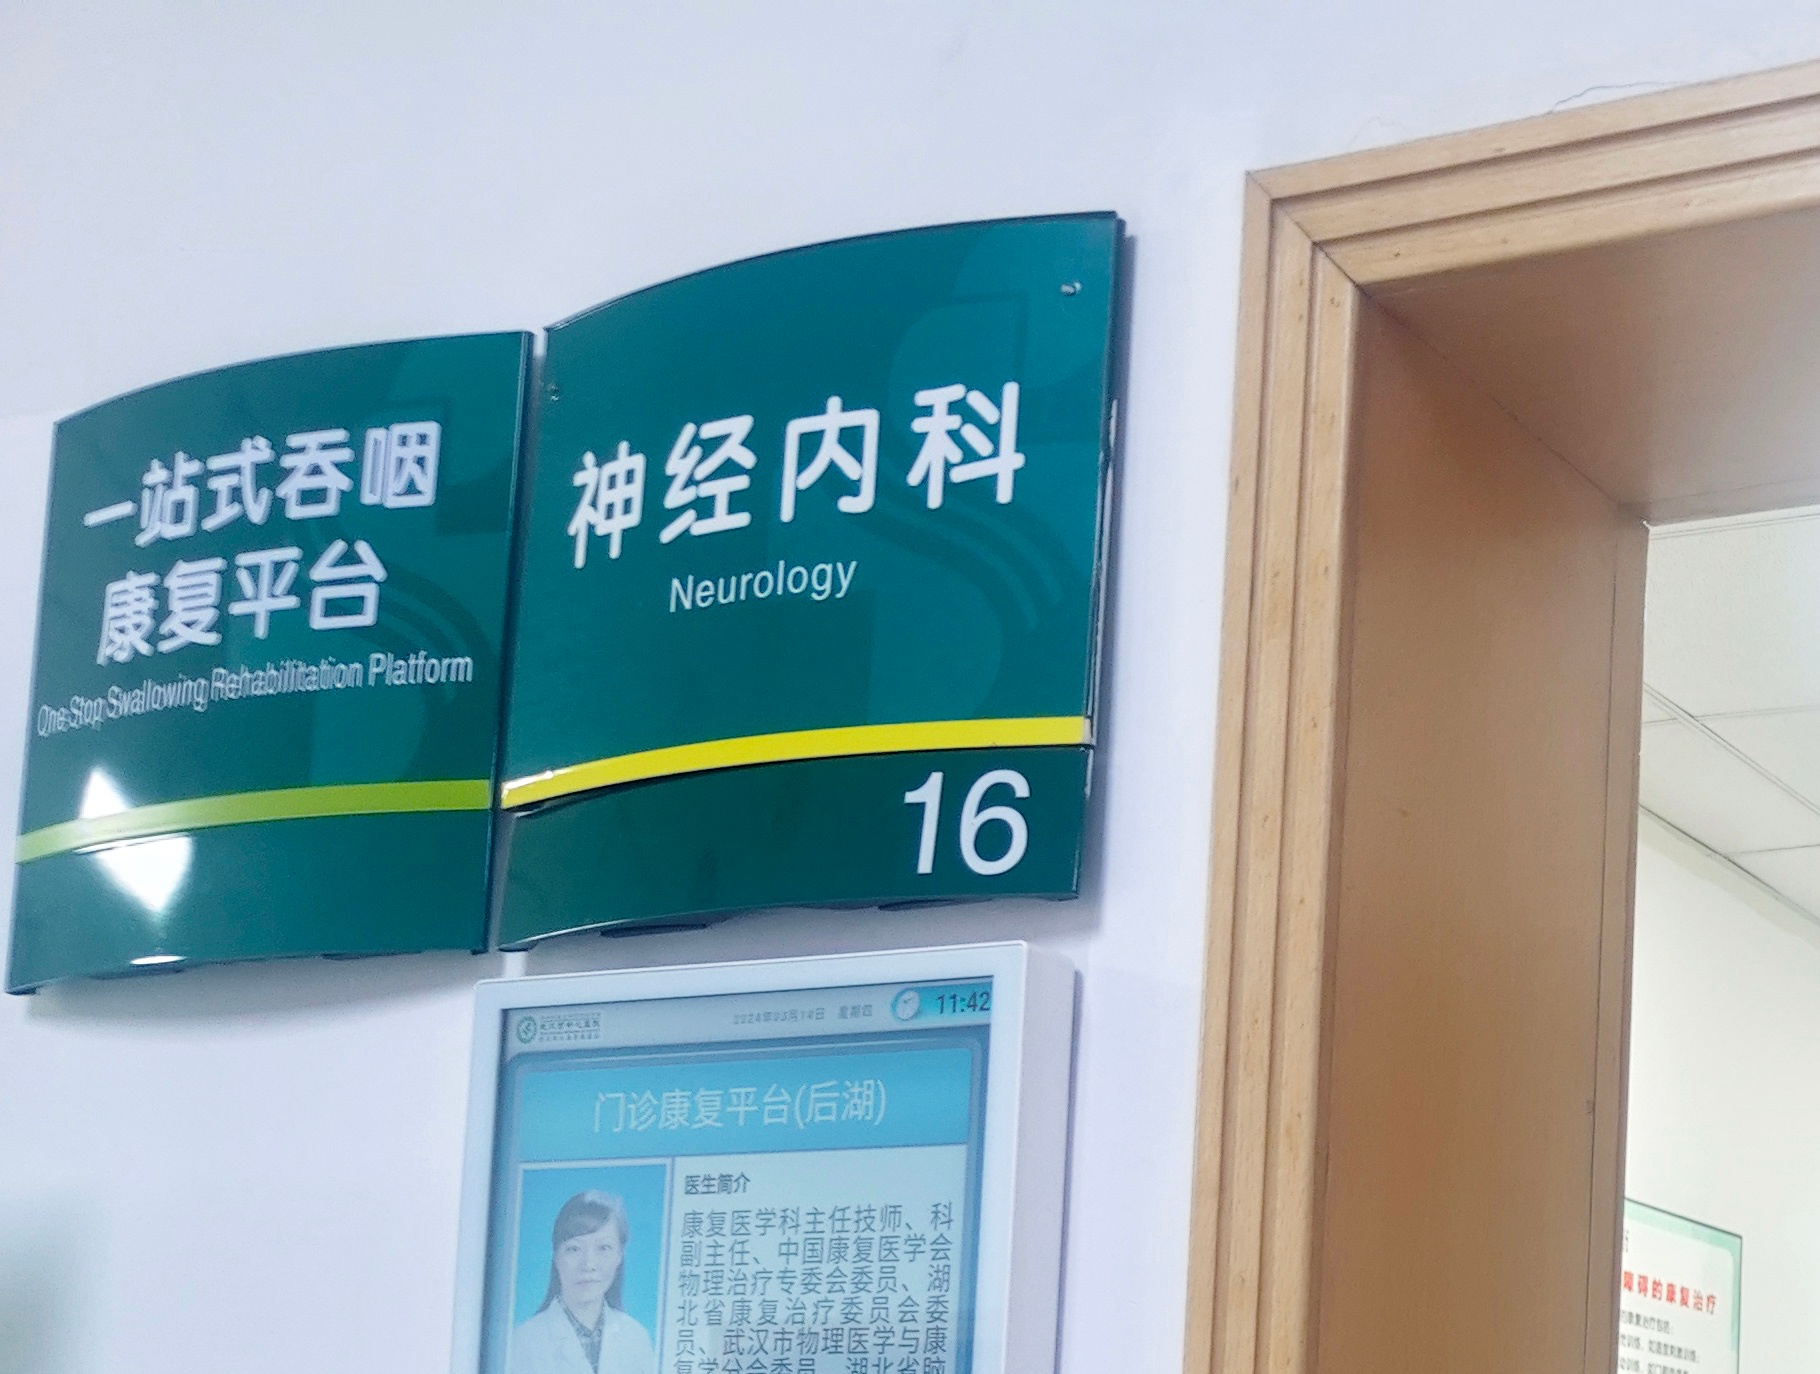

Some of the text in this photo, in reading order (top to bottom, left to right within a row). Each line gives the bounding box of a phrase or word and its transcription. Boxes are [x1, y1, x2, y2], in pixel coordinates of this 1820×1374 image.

[83, 420, 443, 548] 一站式吞咽
[567, 380, 1026, 569] 神经内科
[96, 538, 388, 667] 康复平台
[668, 559, 858, 612] Neurology
[106, 673, 208, 713] Swallowing
[210, 655, 365, 702] Rehabilitation
[367, 649, 475, 688] Platform
[903, 768, 1032, 877] 16
[935, 990, 991, 1016] 11:42
[593, 1078, 887, 1134] 门诊康复平台(后湖)
[684, 1172, 751, 1195] 医生简介
[680, 1201, 954, 1239] 康复医学科主任技师、科
[679, 1233, 953, 1268] 副主任、中国康复医学会
[677, 1264, 951, 1297] 物理治疗专委会委员、湖
[676, 1296, 950, 1327] 北省康复治疗委员会委
[674, 1326, 949, 1357] 员、武汉市物理医学与康
